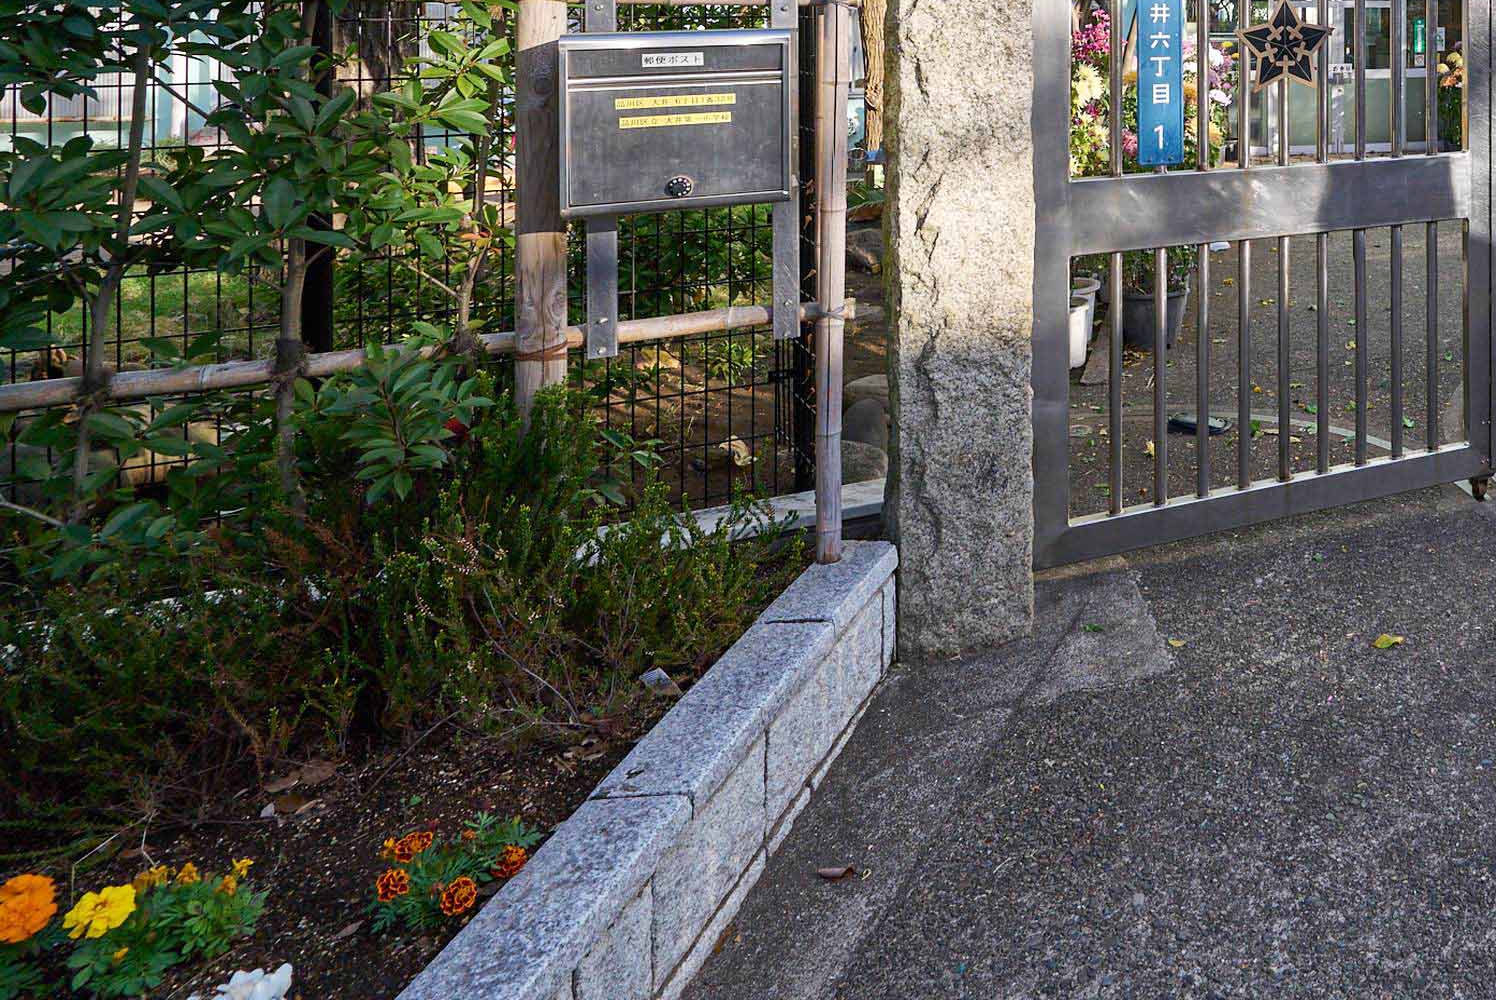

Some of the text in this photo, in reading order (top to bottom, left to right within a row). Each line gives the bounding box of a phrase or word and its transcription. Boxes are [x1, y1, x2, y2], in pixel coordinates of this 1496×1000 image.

[643, 54, 702, 66] 郵便ポスト
[1153, 124, 1165, 150] 1
